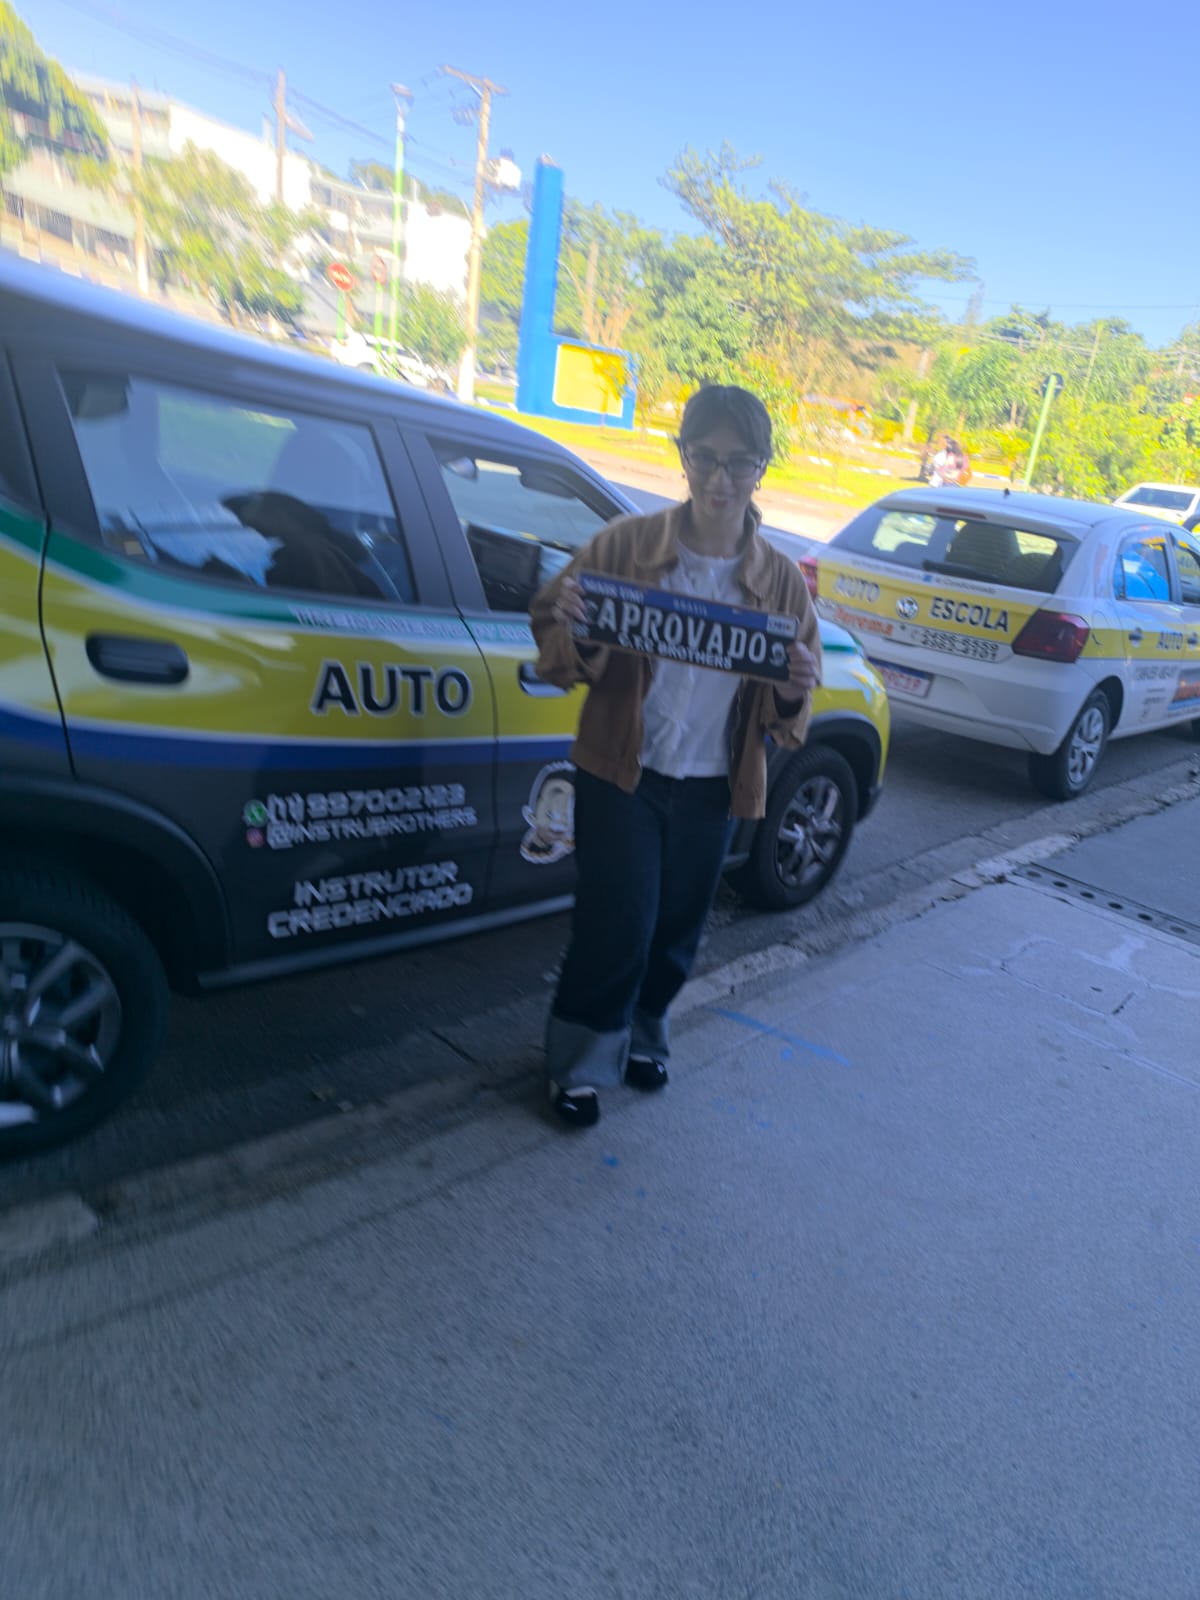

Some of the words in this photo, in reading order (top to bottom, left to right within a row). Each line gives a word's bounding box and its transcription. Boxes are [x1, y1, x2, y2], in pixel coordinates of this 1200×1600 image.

[597, 598, 766, 663] APROVADO
[833, 574, 880, 603] AUTO
[930, 596, 1009, 633] ESCOLA
[657, 641, 733, 670] BROTHERS
[1156, 630, 1184, 650] AUTO
[310, 658, 472, 717] AUTO
[267, 882, 473, 939] CREDENCIADO
[294, 860, 458, 907] INSTRUTOR
